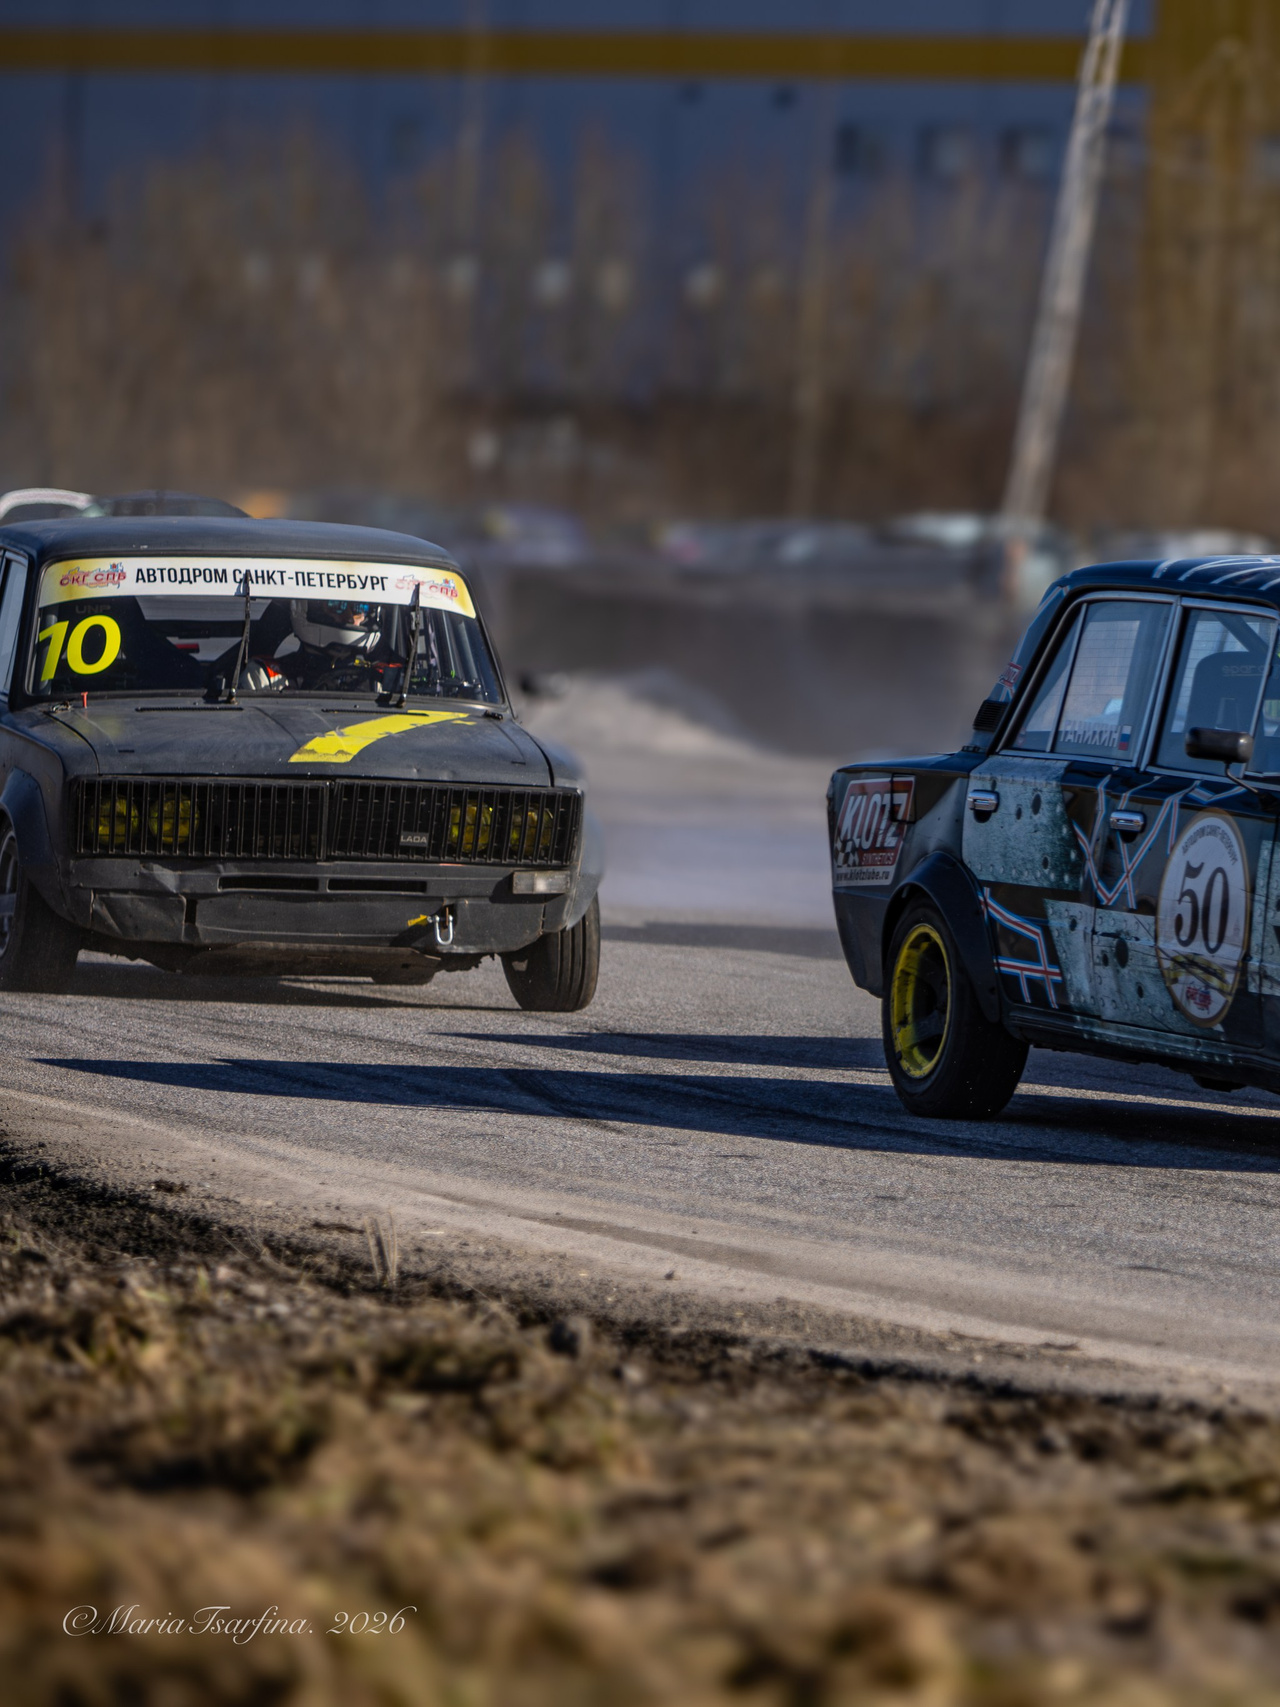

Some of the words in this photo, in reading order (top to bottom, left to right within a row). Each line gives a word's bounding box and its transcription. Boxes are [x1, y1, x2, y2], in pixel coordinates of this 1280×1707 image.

[94, 571, 127, 582] СПБ
[135, 567, 228, 585] АВТОДРОМ
[233, 568, 389, 591] САНКТ-ПЕТЕРБУРГ
[38, 614, 122, 682] 10
[400, 835, 427, 843] LADA
[840, 792, 909, 850] KLOTZ
[1174, 860, 1230, 955] 50
